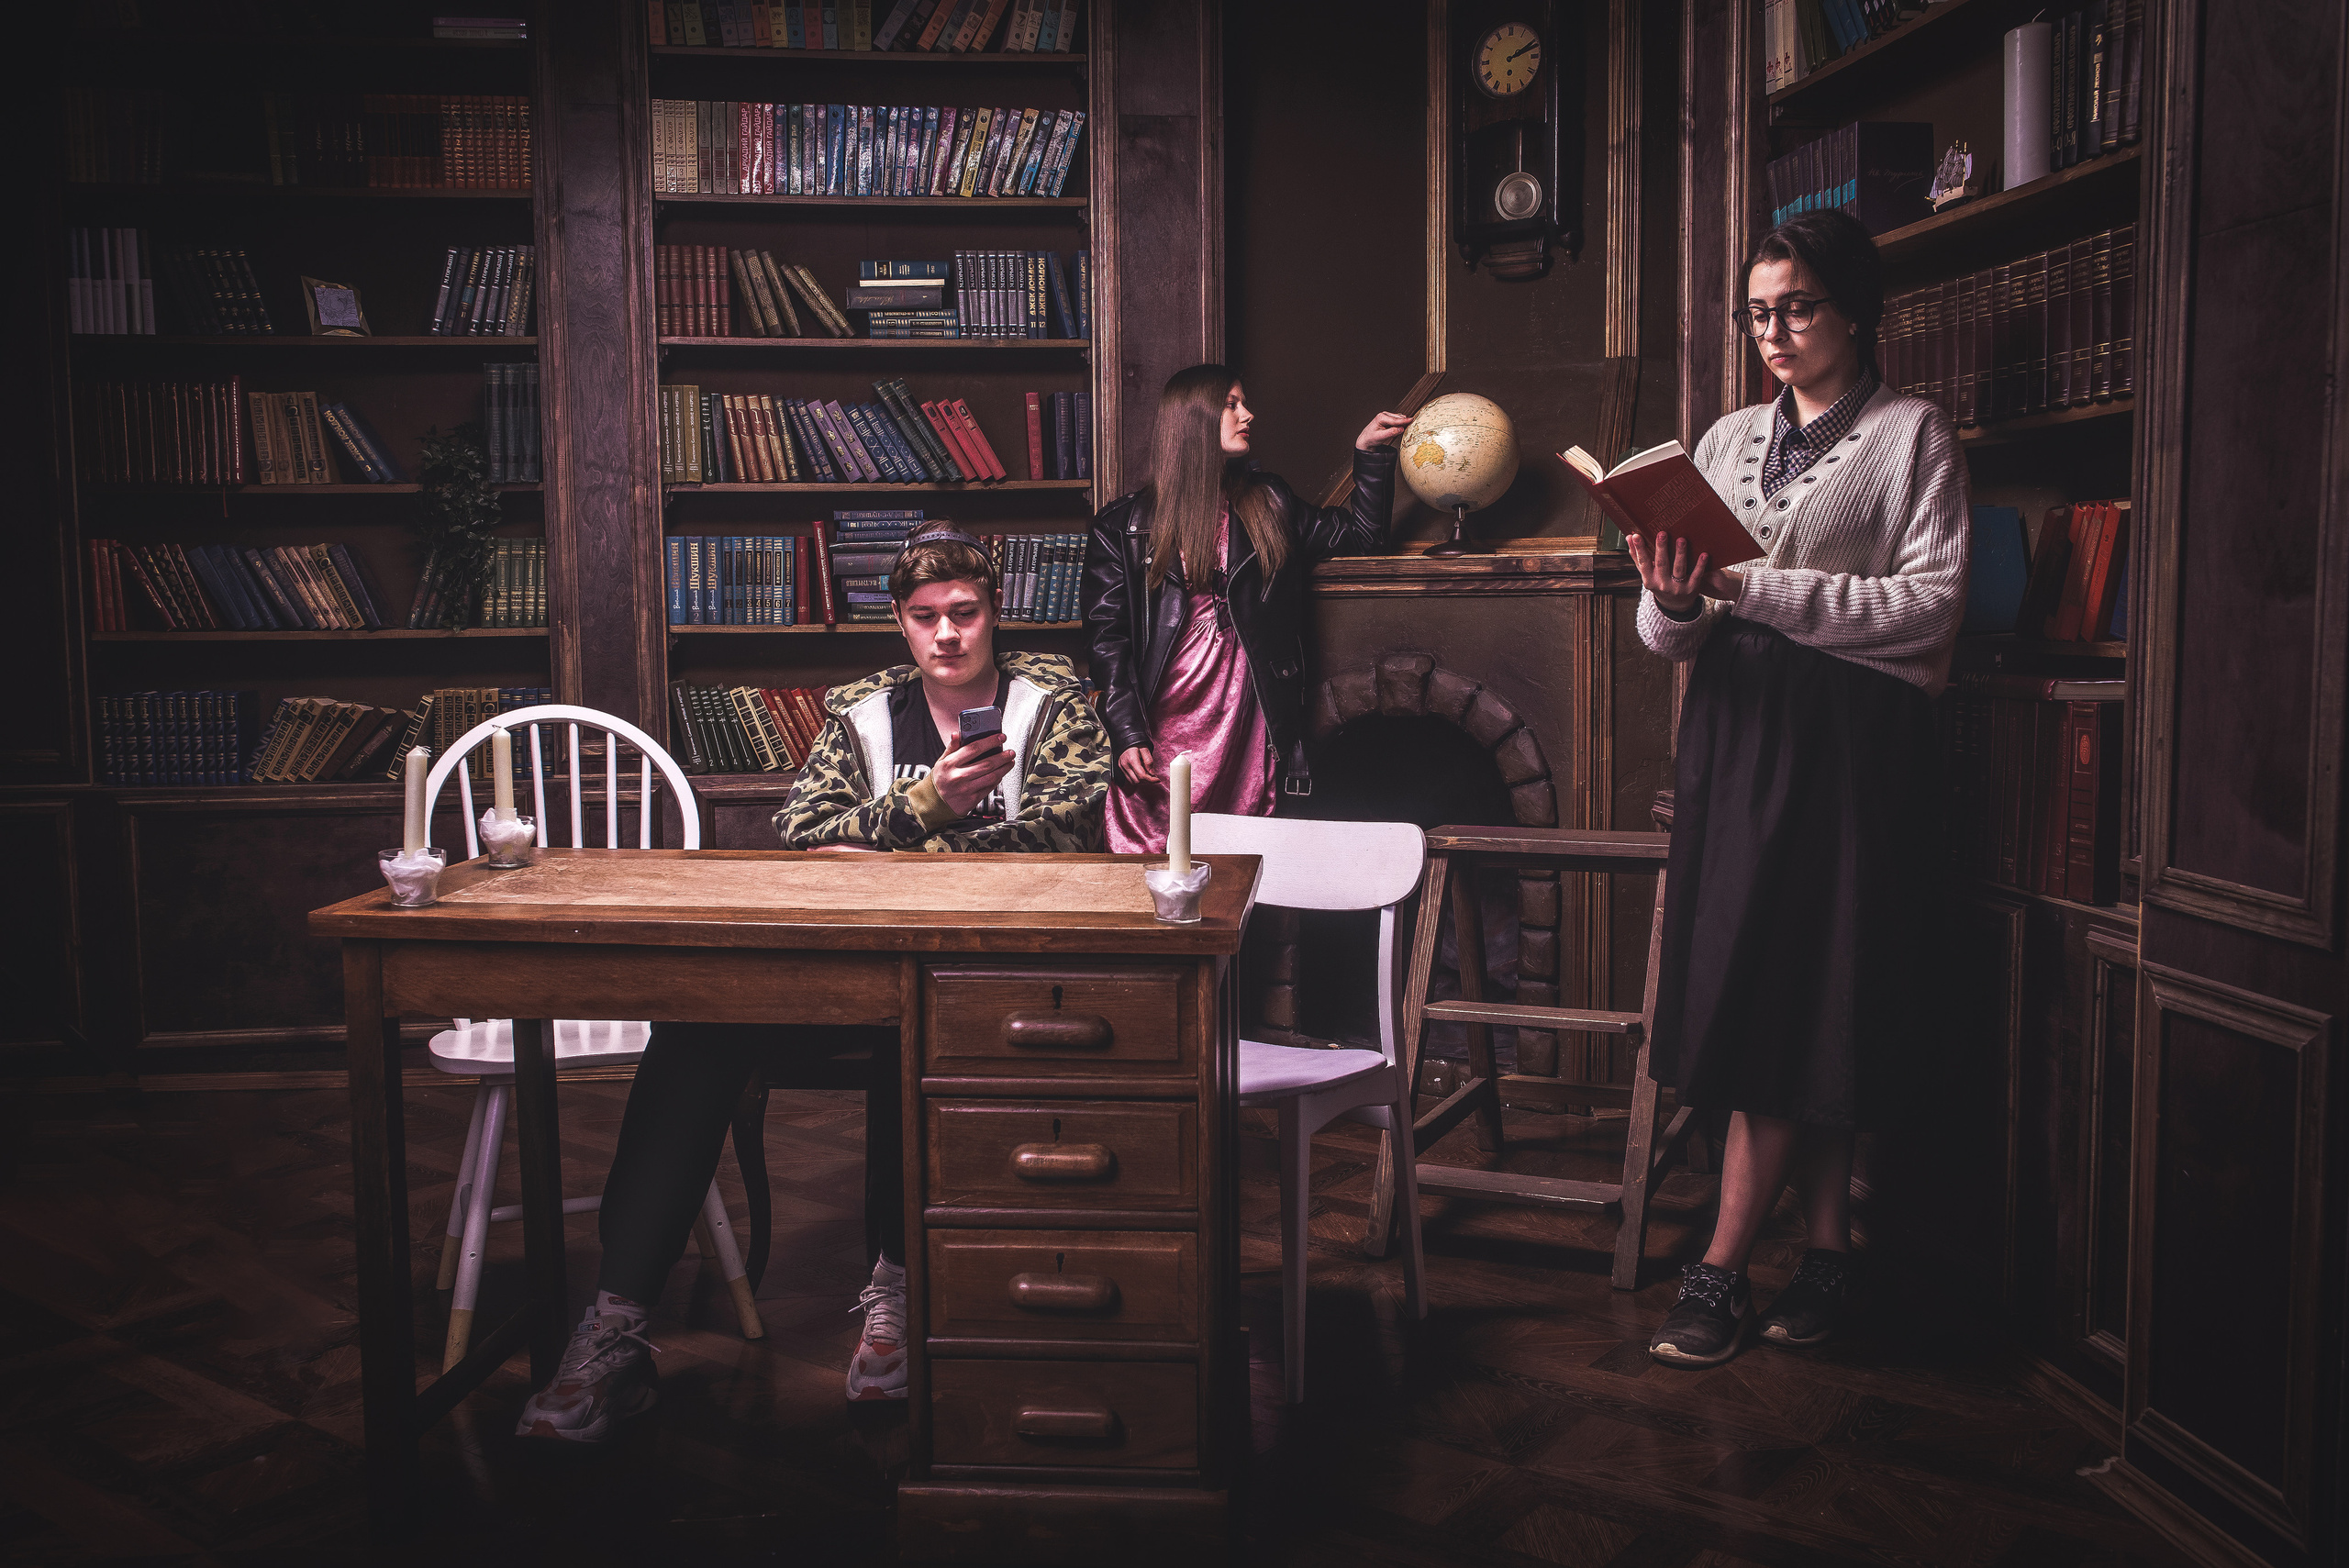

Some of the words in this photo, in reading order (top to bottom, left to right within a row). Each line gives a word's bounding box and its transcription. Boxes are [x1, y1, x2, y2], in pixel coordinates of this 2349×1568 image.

[741, 107, 750, 135] ГАЙДАР
[765, 110, 774, 138] ГАЙДАР
[741, 137, 750, 172] АРКАДИЙ
[767, 183, 774, 192] 2
[1080, 256, 1088, 289] ЛОНДОН
[324, 409, 349, 443] ЛОНДОН
[337, 409, 363, 440] ЛОНДОН
[345, 439, 365, 462] ДЖЕК
[708, 469, 713, 477] 6
[671, 542, 682, 588] Шукшин
[690, 542, 701, 590] Шукшин
[707, 542, 718, 590] Шукшин
[317, 557, 360, 624] СТЕНДАЛЬ
[727, 599, 731, 607] 1
[737, 599, 742, 607] 2
[747, 599, 752, 607] 3
[756, 599, 762, 607] 4
[765, 599, 771, 607] 5
[775, 599, 781, 607] 6
[786, 599, 791, 607] 7
[693, 612, 699, 622] 2
